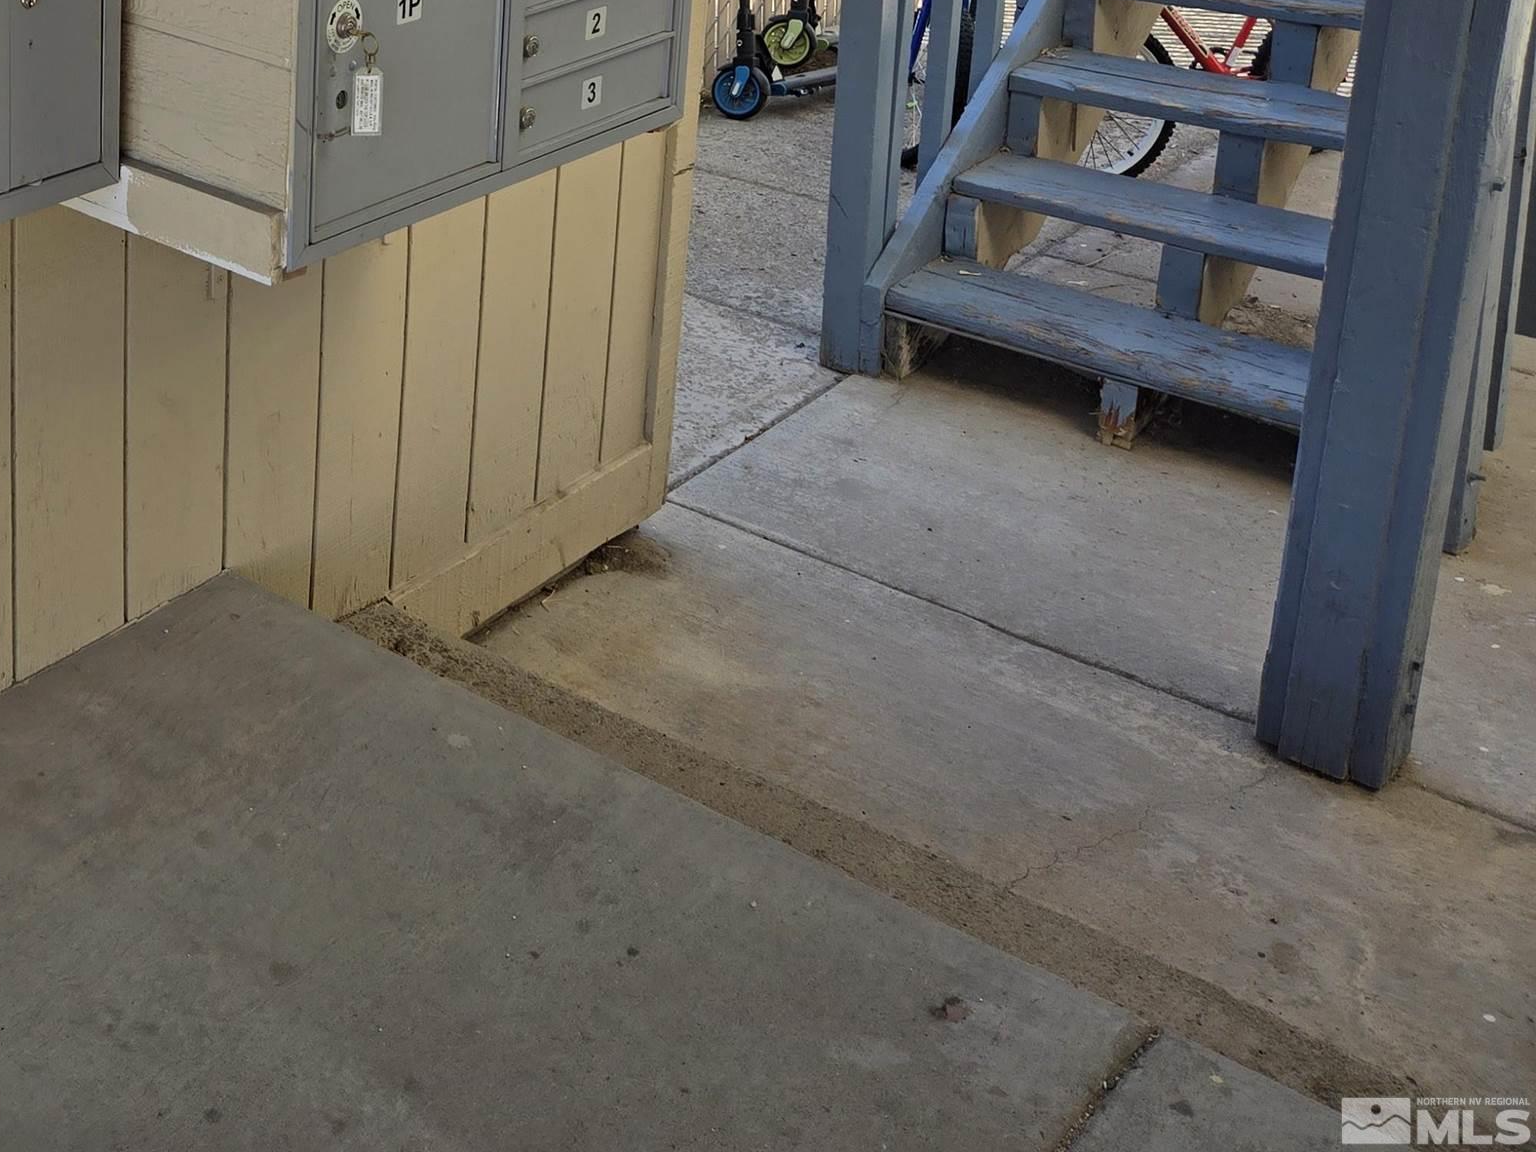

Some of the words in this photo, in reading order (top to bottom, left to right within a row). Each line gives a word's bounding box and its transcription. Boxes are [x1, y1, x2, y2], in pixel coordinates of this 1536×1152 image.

[337, 0, 355, 13] OPEN
[591, 13, 601, 34] 2
[587, 82, 596, 103] 3
